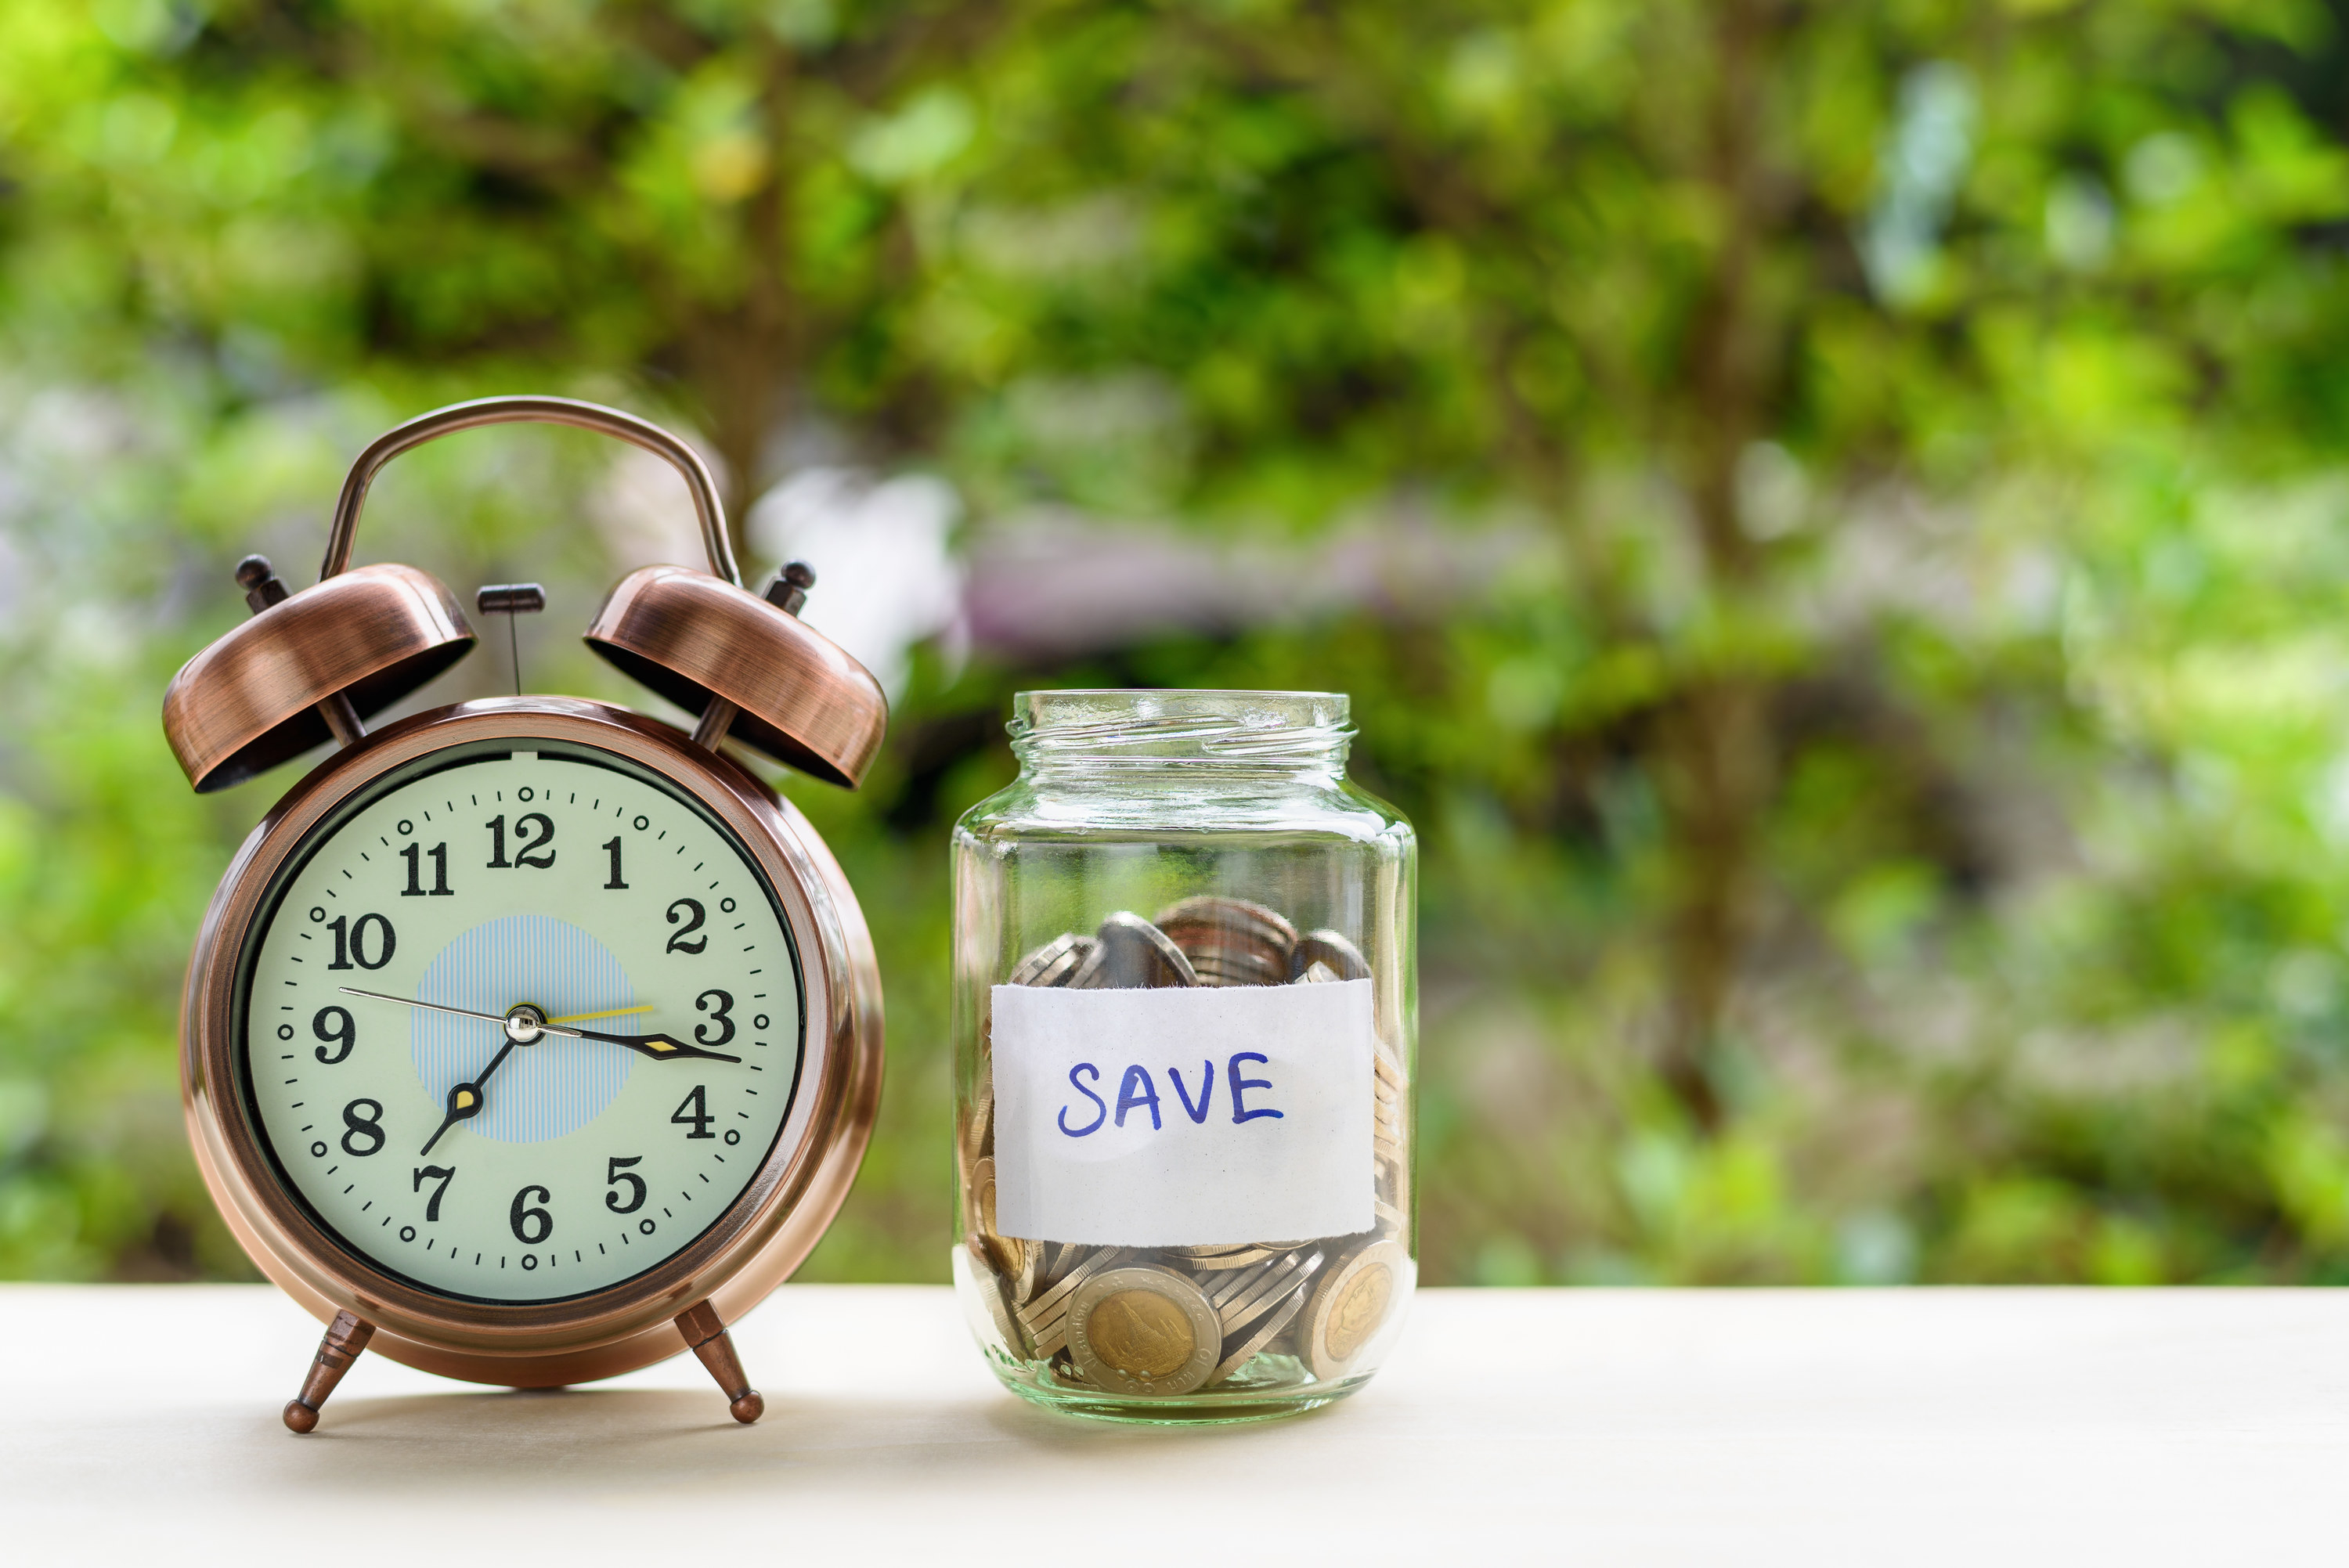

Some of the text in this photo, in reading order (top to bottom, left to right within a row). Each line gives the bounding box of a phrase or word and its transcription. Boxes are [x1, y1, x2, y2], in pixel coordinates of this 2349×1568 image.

[399, 842, 454, 896] 11
[485, 813, 557, 870] 12
[602, 836, 630, 890] 1
[326, 913, 396, 971] 10
[666, 898, 709, 955] 2
[312, 1005, 356, 1065] 9
[694, 989, 736, 1047] 3
[670, 1085, 716, 1139] 4
[1057, 1051, 1284, 1137] SAVE
[341, 1098, 386, 1157] 8
[413, 1165, 456, 1222] 7
[605, 1155, 648, 1214] 5
[510, 1184, 554, 1245] 6
